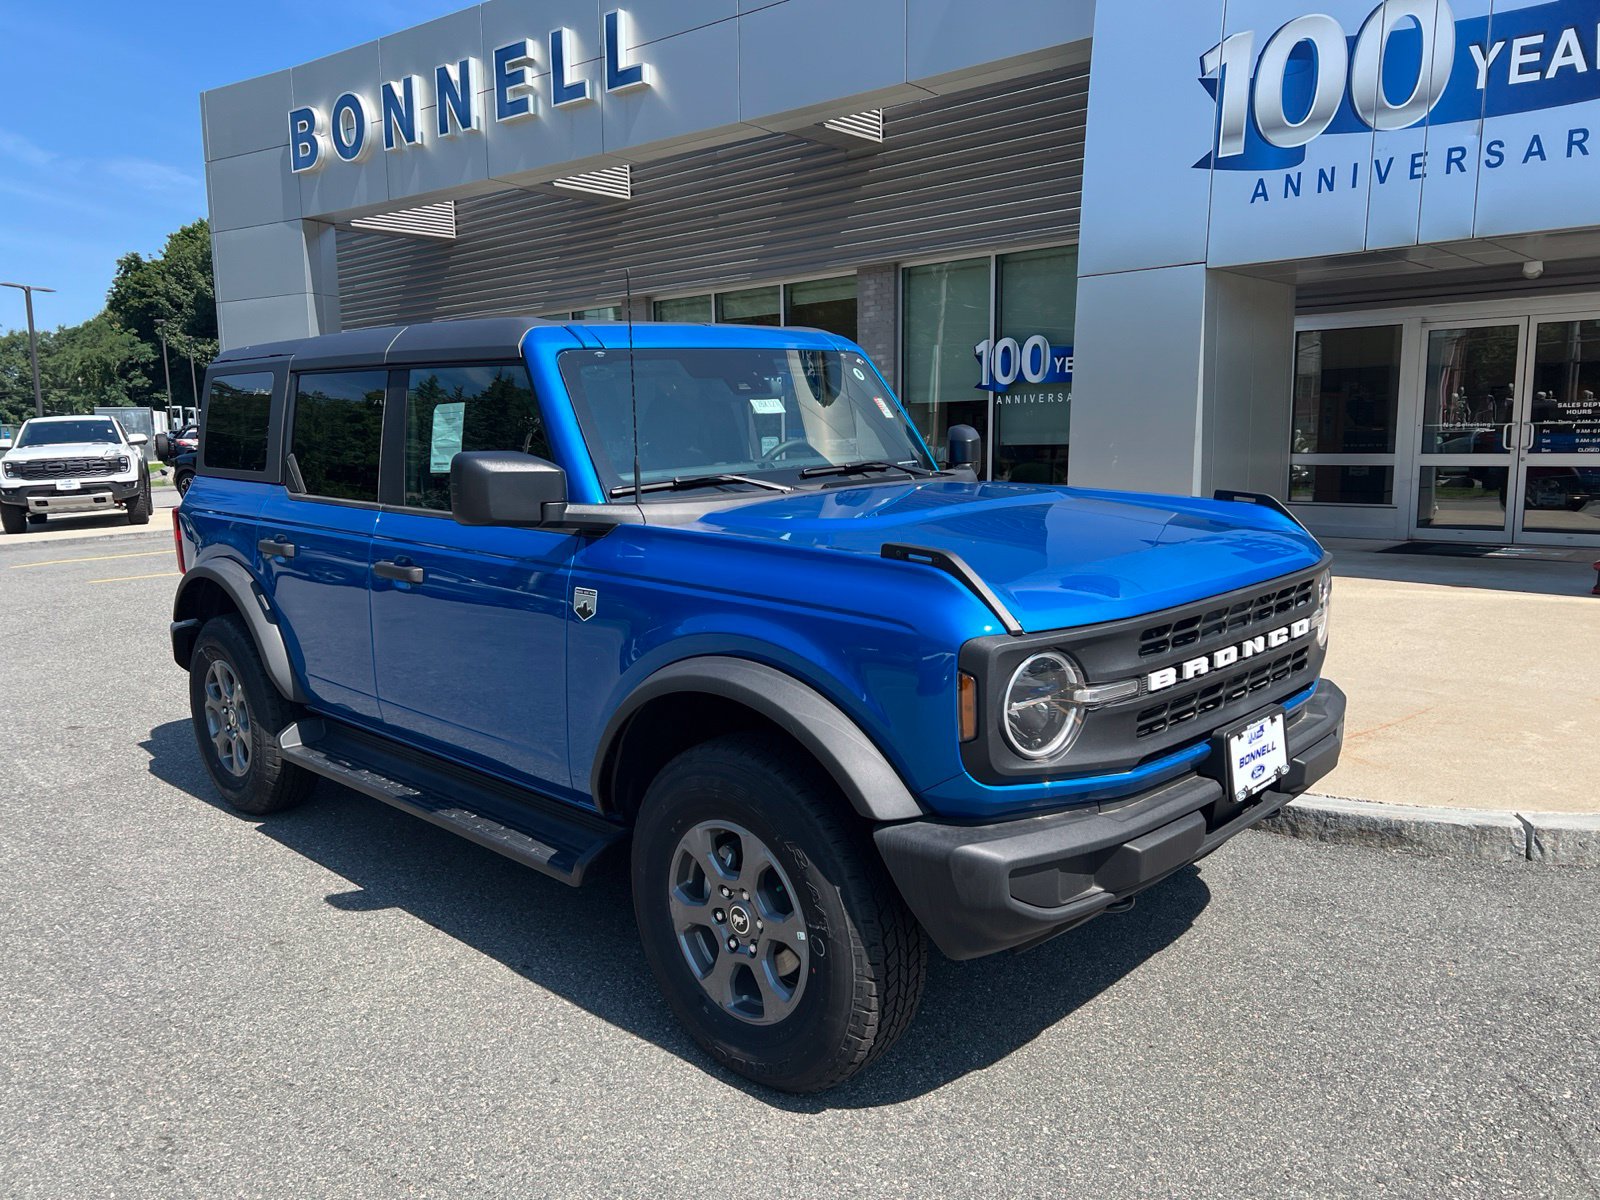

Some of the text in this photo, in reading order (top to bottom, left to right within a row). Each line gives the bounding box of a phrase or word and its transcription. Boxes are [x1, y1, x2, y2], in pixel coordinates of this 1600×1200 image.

[287, 7, 652, 174] BONNELL
[1200, 0, 1600, 158] 100 YEA
[1249, 127, 1590, 204] ANNIVERSAR
[974, 334, 1051, 386] 100
[1147, 618, 1310, 692] BRONCO
[1239, 741, 1276, 768] BONNELL
